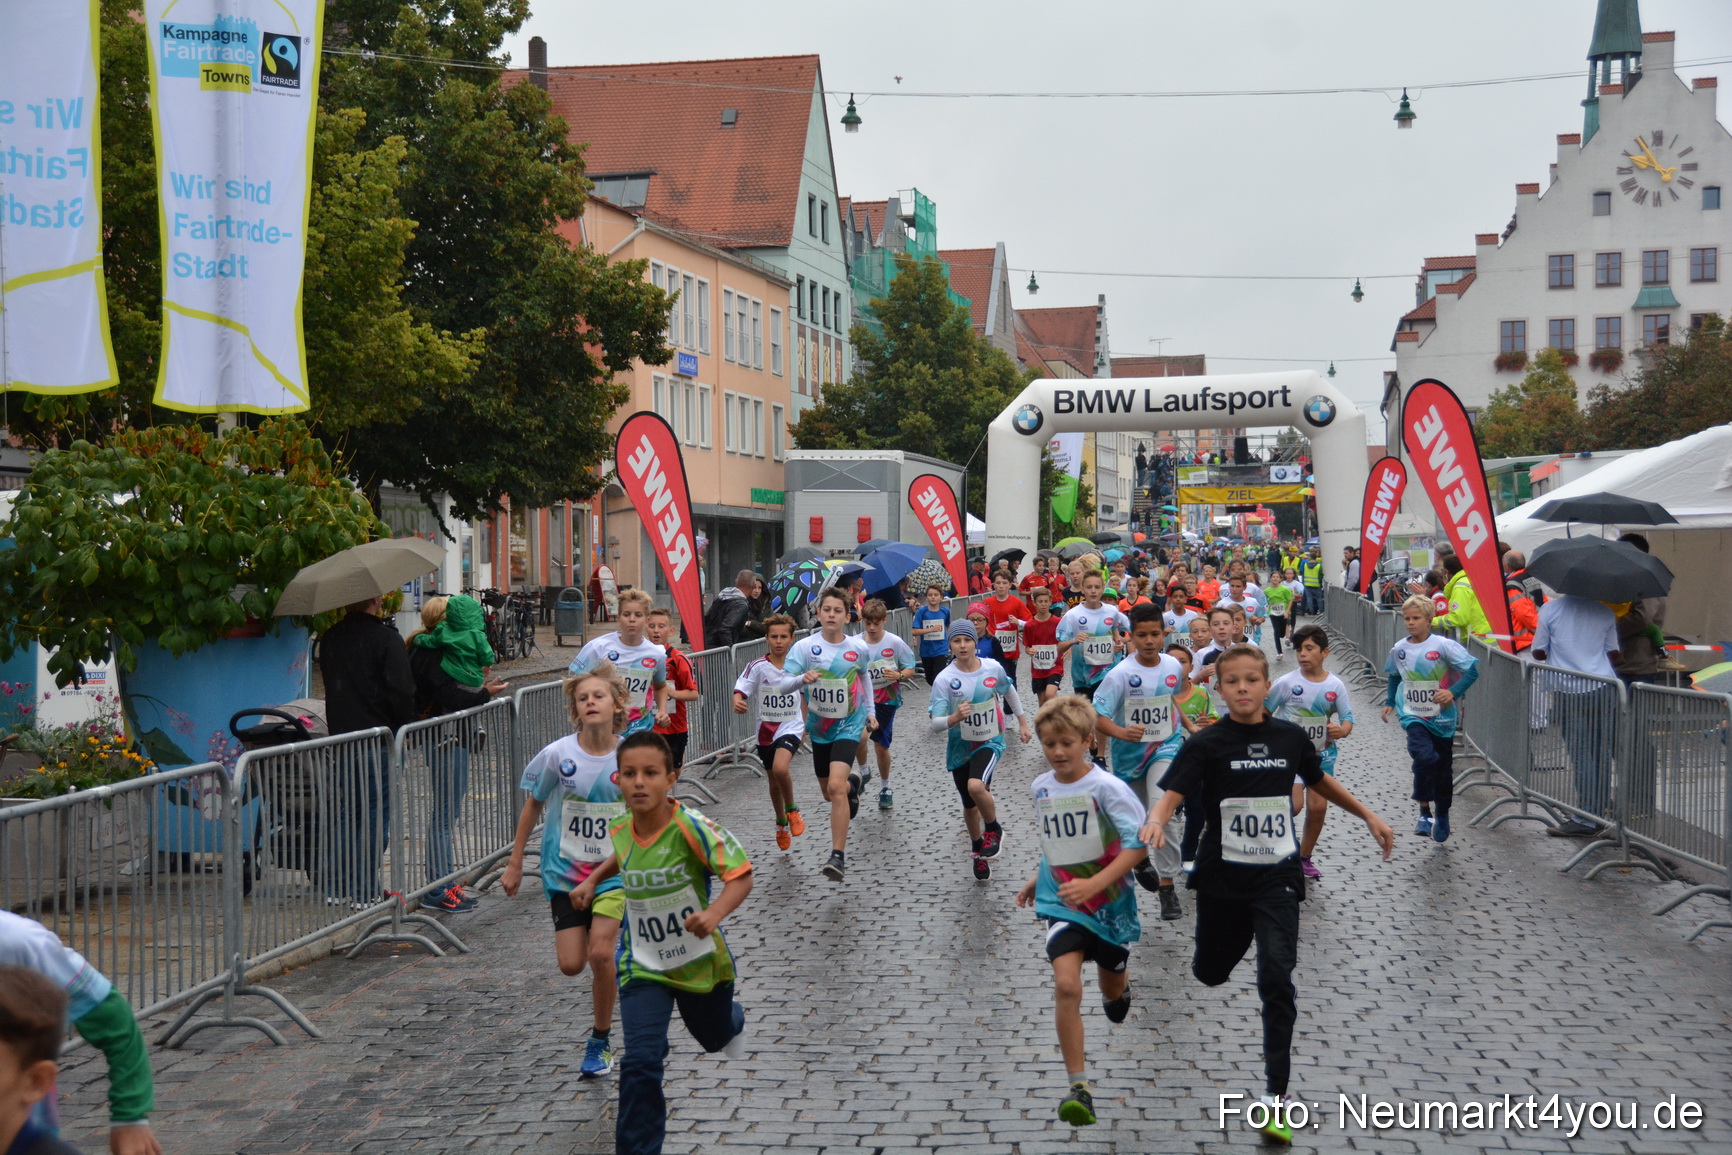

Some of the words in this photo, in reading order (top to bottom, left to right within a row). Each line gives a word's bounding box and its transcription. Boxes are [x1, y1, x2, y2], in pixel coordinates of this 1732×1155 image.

[163, 24, 248, 44] Kampagne
[163, 40, 256, 64] Fairtrade
[202, 69, 250, 85] Towns
[262, 75, 298, 87] FAIRTRADE
[170, 172, 217, 199] Wir
[225, 175, 271, 205] sind
[173, 252, 249, 279] Stadt
[1053, 389, 1136, 414] BMW
[1144, 384, 1292, 416] Laufsport
[1227, 490, 1255, 500] ZIEL
[1365, 467, 1400, 546] REWE
[1035, 651, 1055, 661] 4001
[1087, 642, 1112, 655] 4102
[625, 677, 648, 693] 024
[762, 695, 794, 709] 4033
[812, 687, 845, 704] 4016
[1406, 689, 1436, 703] 4003
[817, 705, 837, 713] Jannick
[1130, 706, 1168, 725] 4034
[964, 708, 995, 727] 4017
[1144, 728, 1160, 736] slam
[1308, 725, 1324, 739] 09
[1230, 759, 1287, 770] STANNO
[568, 816, 611, 840] 403
[1043, 811, 1089, 838] 4107
[1229, 813, 1286, 838] 4043
[584, 844, 601, 854] Luis
[1243, 844, 1275, 855] Lorenz
[658, 944, 687, 961] Farid
